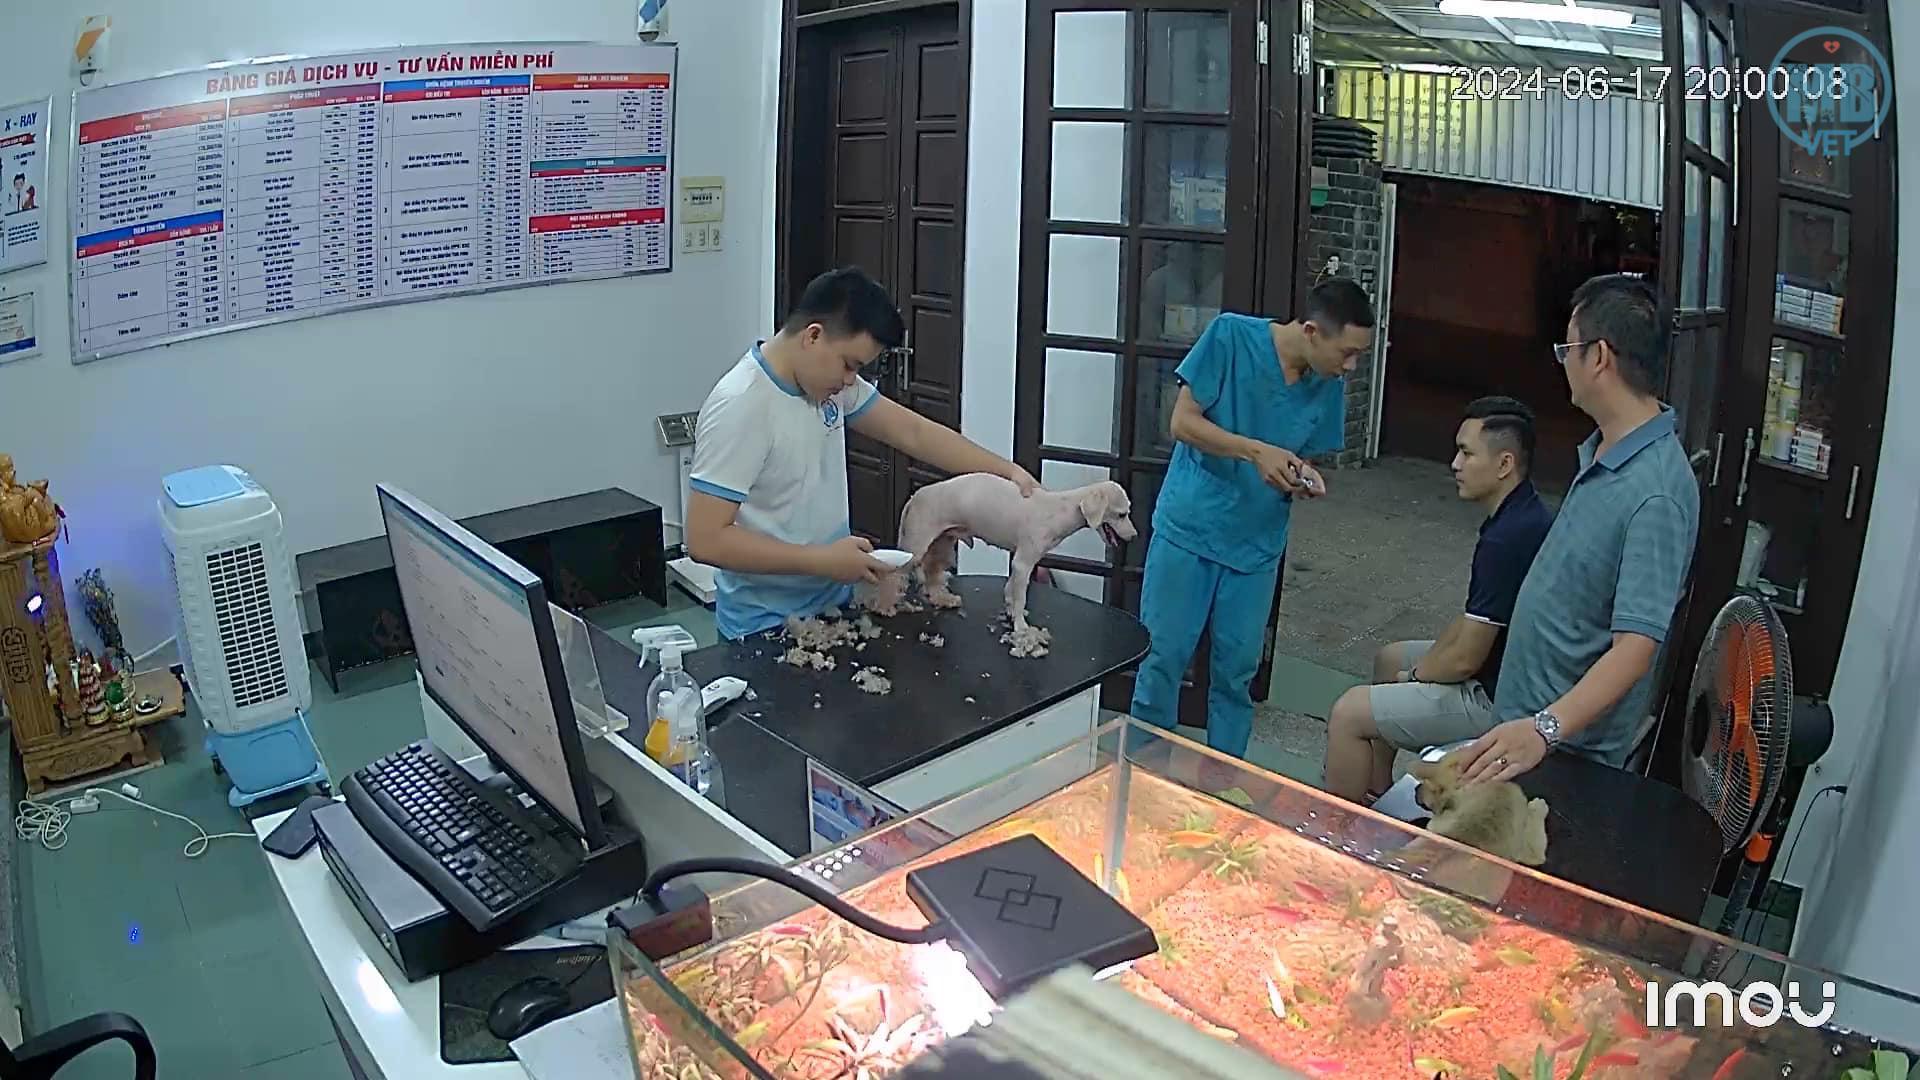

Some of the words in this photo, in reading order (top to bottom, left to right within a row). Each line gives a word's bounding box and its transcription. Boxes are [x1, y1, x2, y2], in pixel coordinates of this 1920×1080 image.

[207, 72, 258, 94] BẢNG
[265, 67, 296, 86] GIÁ
[303, 64, 348, 84] DỊCH
[354, 62, 378, 79] VỤ
[398, 57, 422, 73] TƯ
[427, 52, 463, 72] VẤN
[523, 50, 554, 68] PHÍ
[5, 118, 12, 131] X
[20, 112, 37, 128] RAY
